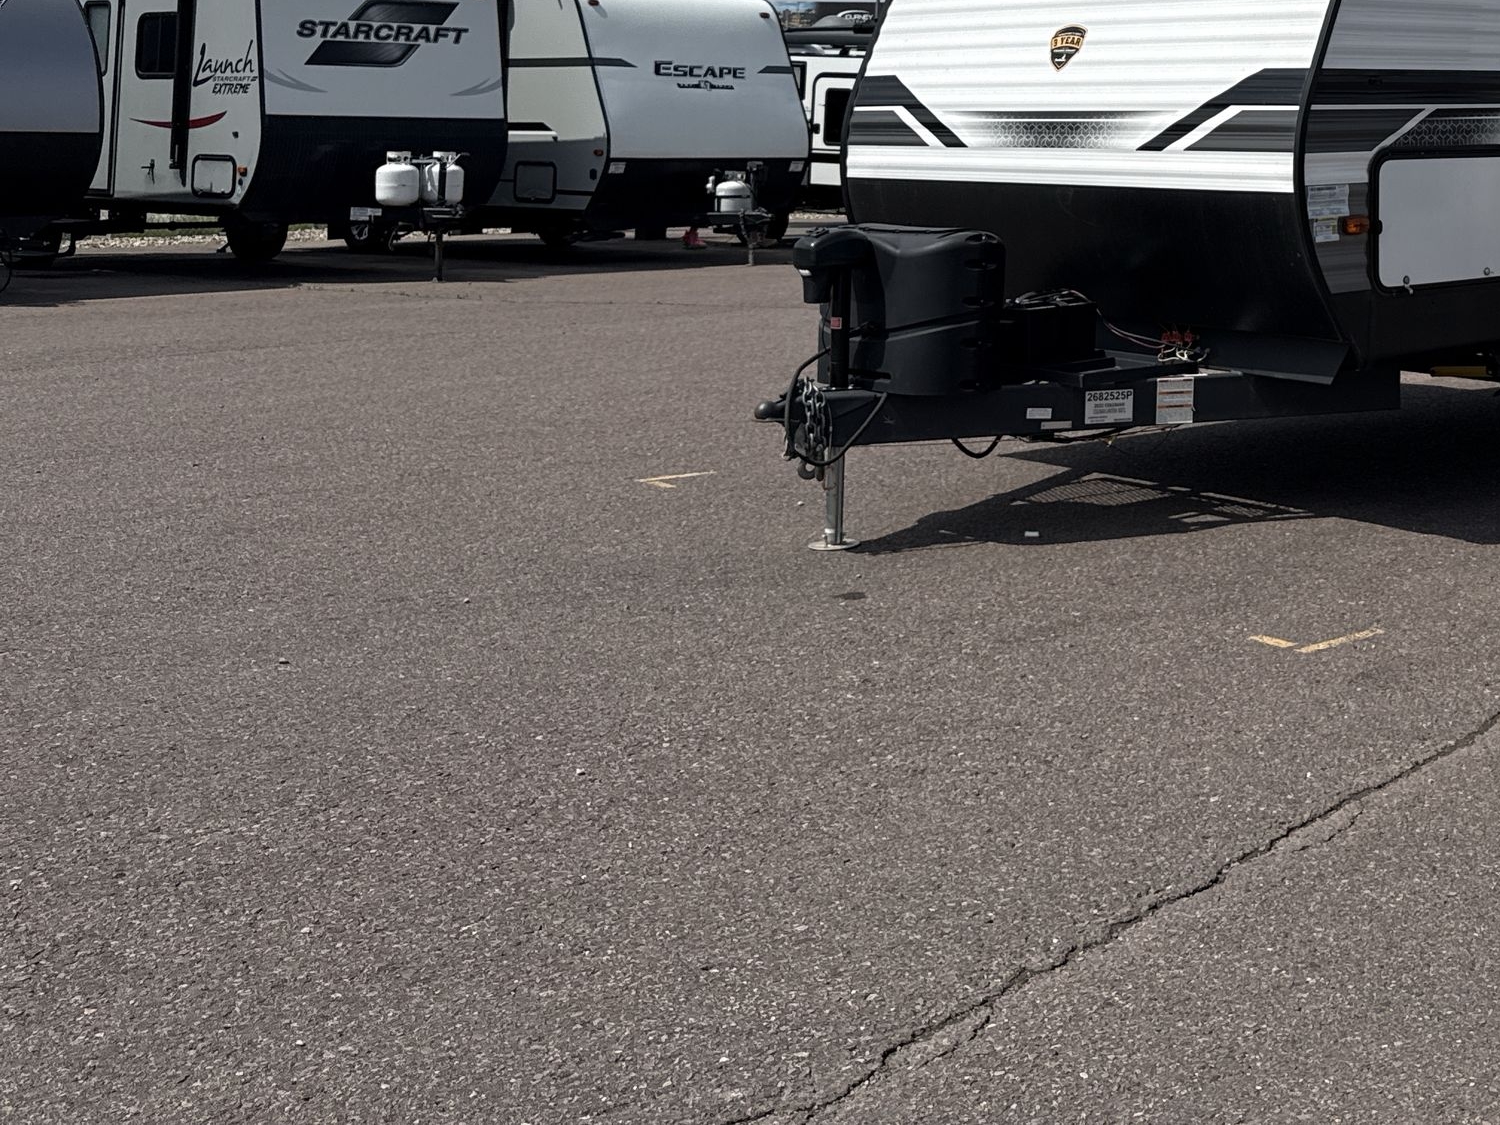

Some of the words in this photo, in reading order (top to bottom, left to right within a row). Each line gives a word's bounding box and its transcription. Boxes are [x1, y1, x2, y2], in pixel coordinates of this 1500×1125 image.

[297, 19, 469, 44] STARCRAFT
[1060, 36, 1082, 47] YEAR
[193, 39, 254, 87] Launch
[654, 60, 745, 79] ESCAPE
[212, 83, 251, 95] EXTREME
[1087, 390, 1133, 402] 2682525P
